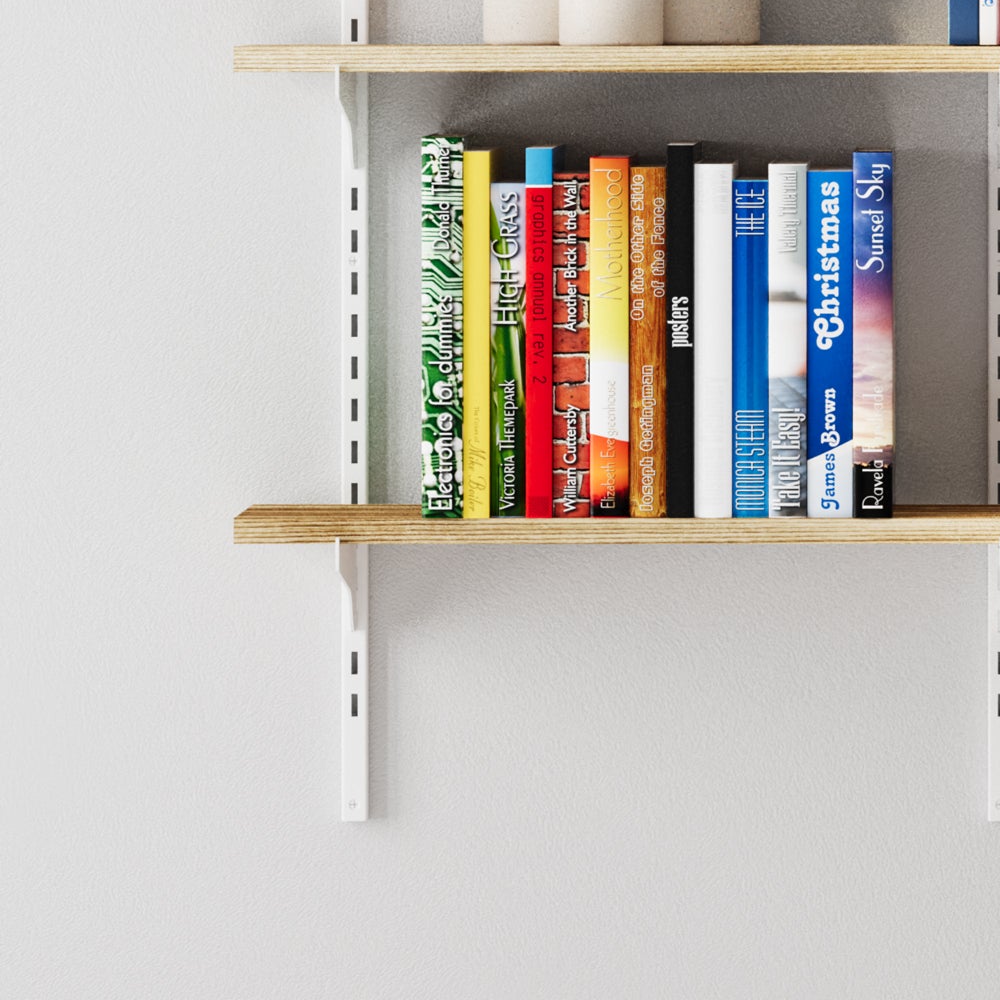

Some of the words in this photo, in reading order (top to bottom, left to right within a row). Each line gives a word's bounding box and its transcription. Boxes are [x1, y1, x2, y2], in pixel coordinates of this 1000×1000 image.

[630, 174, 645, 211] Side
[735, 189, 765, 209] ICE
[855, 163, 891, 202] Sky
[432, 201, 450, 250] Donald
[491, 191, 520, 259] GRASS
[530, 194, 547, 263] graphics
[564, 210, 577, 230] the
[564, 233, 577, 244] in
[593, 168, 623, 301] Motherhood
[630, 215, 645, 263] Other
[651, 197, 666, 245] Fence
[735, 213, 765, 237] THE
[855, 209, 885, 273] Sunset
[563, 247, 577, 278] Brick
[630, 267, 645, 294] the
[651, 249, 665, 276] the
[813, 181, 845, 351] Christmas
[532, 272, 546, 322] annual
[563, 281, 577, 332] Another
[630, 298, 645, 321] On
[651, 280, 665, 298] of
[428, 295, 453, 374] dummies
[667, 296, 693, 348] posters
[533, 333, 544, 365] rev.
[428, 381, 453, 406] for
[533, 376, 545, 384] 2
[563, 403, 580, 464] Cuttersby
[600, 379, 618, 458] Evergreenhouse
[735, 409, 765, 456] STEAM
[771, 407, 806, 450] Easy!
[820, 387, 841, 447] Brown
[428, 413, 453, 511] Electronics
[771, 453, 801, 466] It
[820, 453, 840, 510] James
[563, 467, 577, 512] William
[600, 462, 617, 509] Elizabeth
[735, 460, 765, 511] MONICA
[771, 471, 801, 511] Take
[862, 460, 885, 510] Ravela
